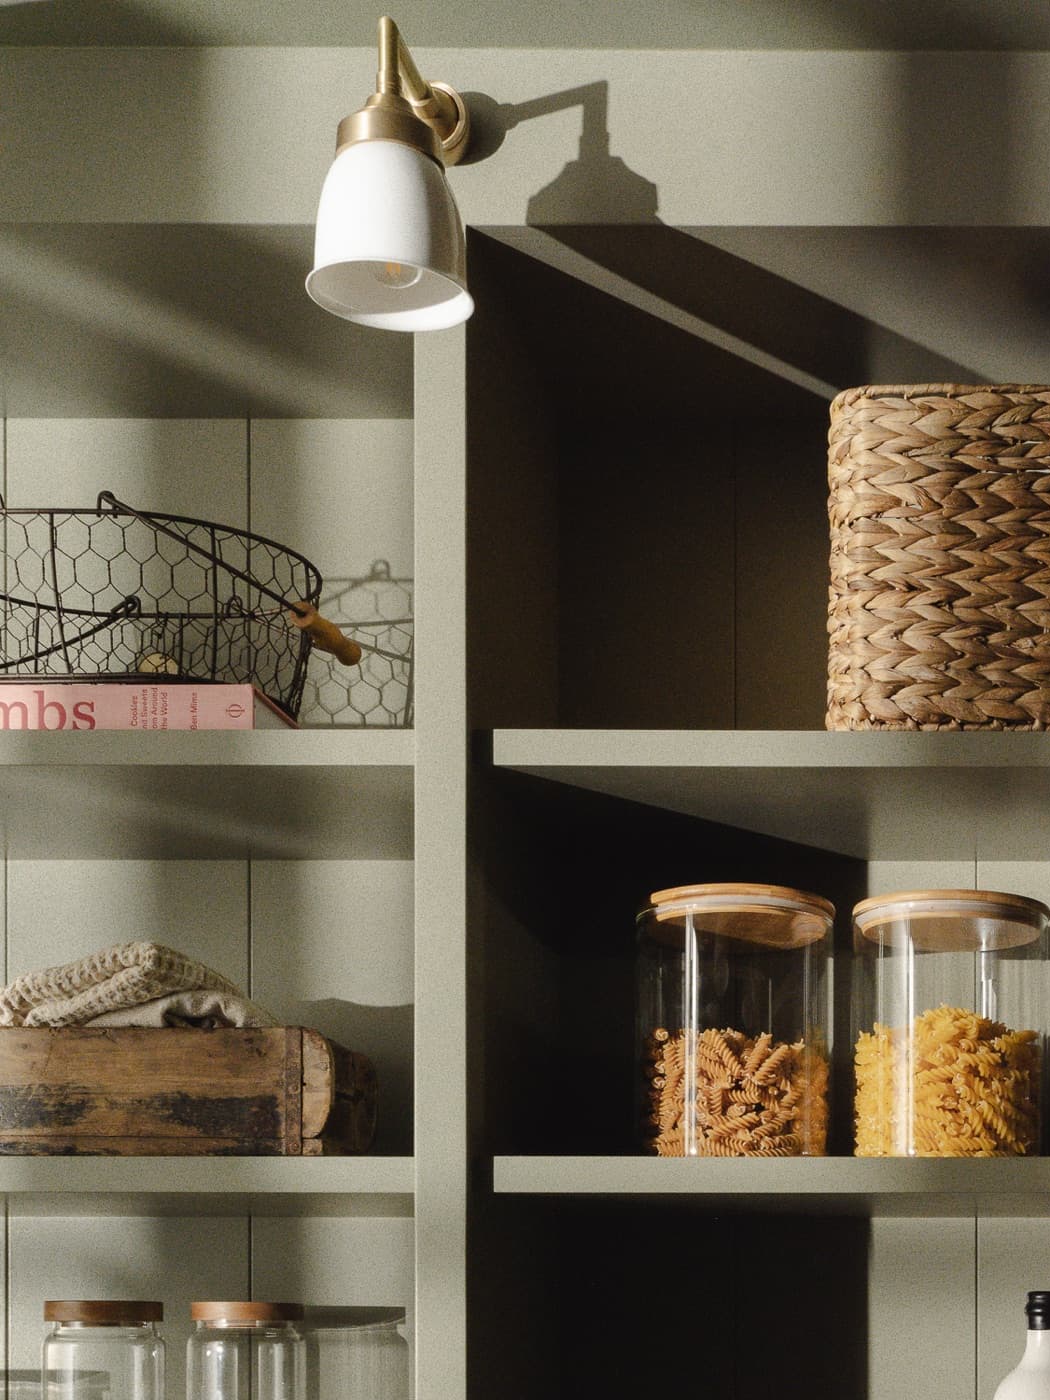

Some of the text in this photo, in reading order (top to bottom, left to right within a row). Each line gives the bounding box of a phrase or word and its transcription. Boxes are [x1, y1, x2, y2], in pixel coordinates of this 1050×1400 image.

[150, 687, 158, 716] Around
[160, 692, 168, 716] World
[190, 692, 198, 730] Ben Mims
[140, 719, 148, 729] nd
